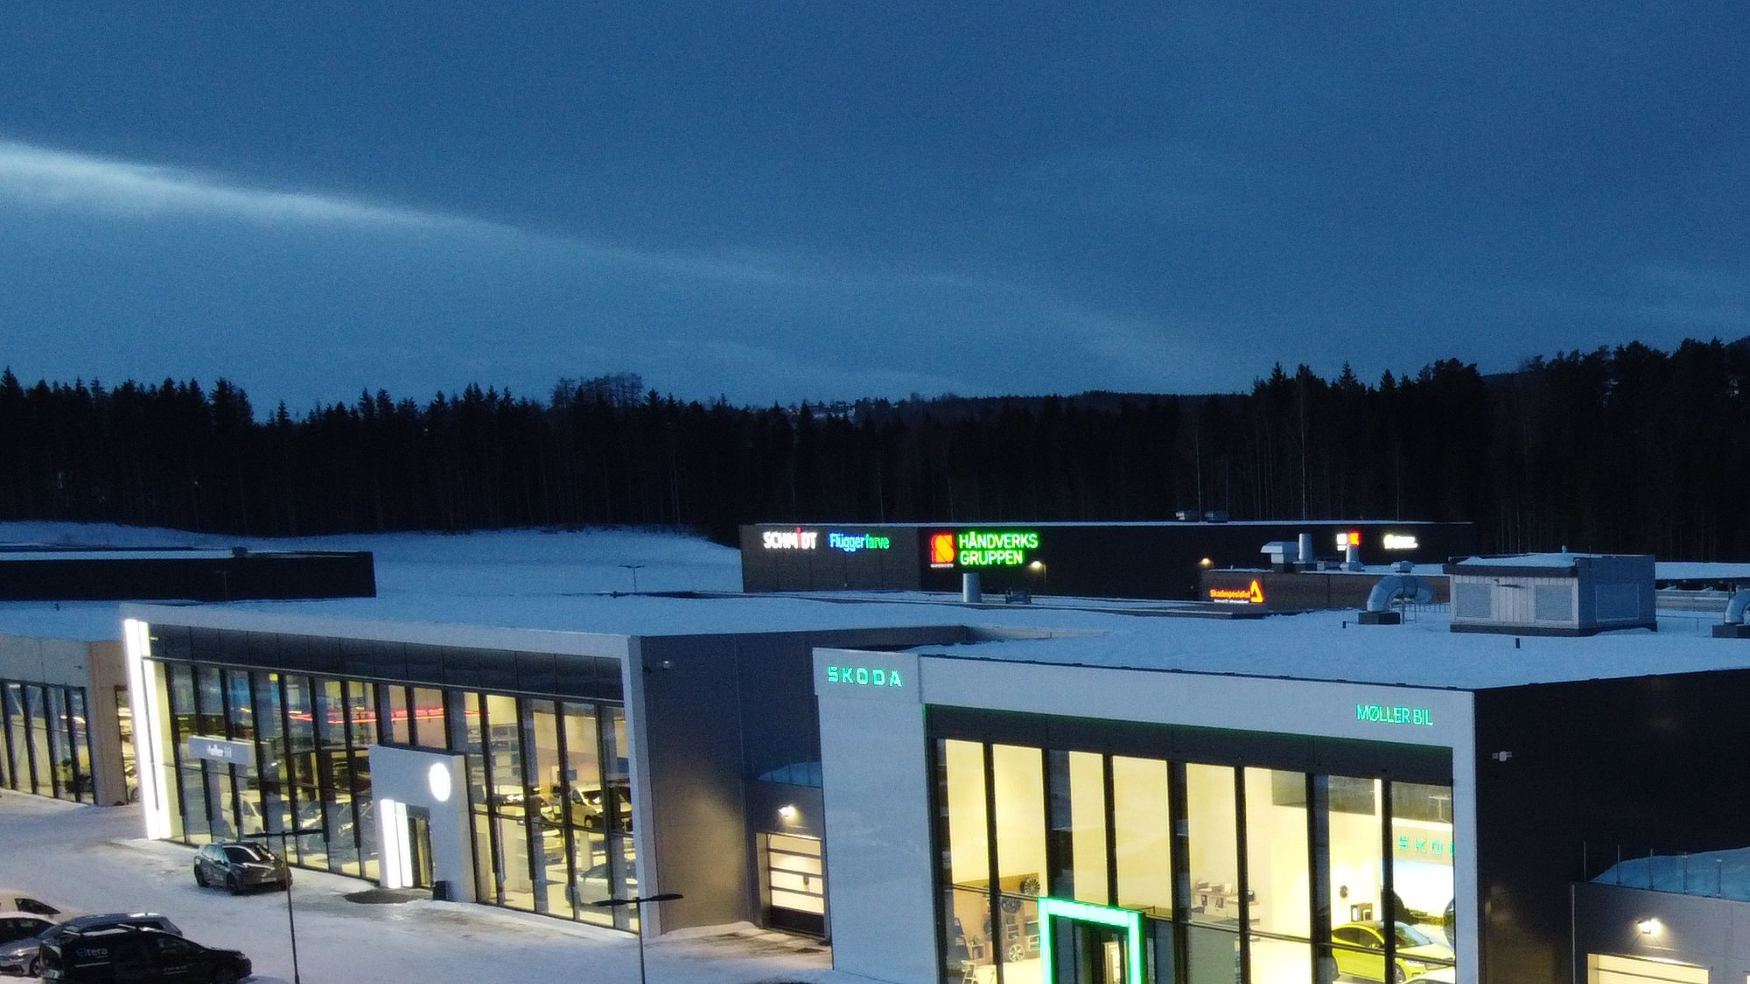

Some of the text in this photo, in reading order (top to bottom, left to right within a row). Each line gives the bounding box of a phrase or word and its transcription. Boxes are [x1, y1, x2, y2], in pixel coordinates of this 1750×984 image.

[959, 531, 1039, 549] HÅNDVERKS
[960, 550, 1023, 566] GRUPPEN
[1357, 704, 1433, 726] MØLLER BIL
